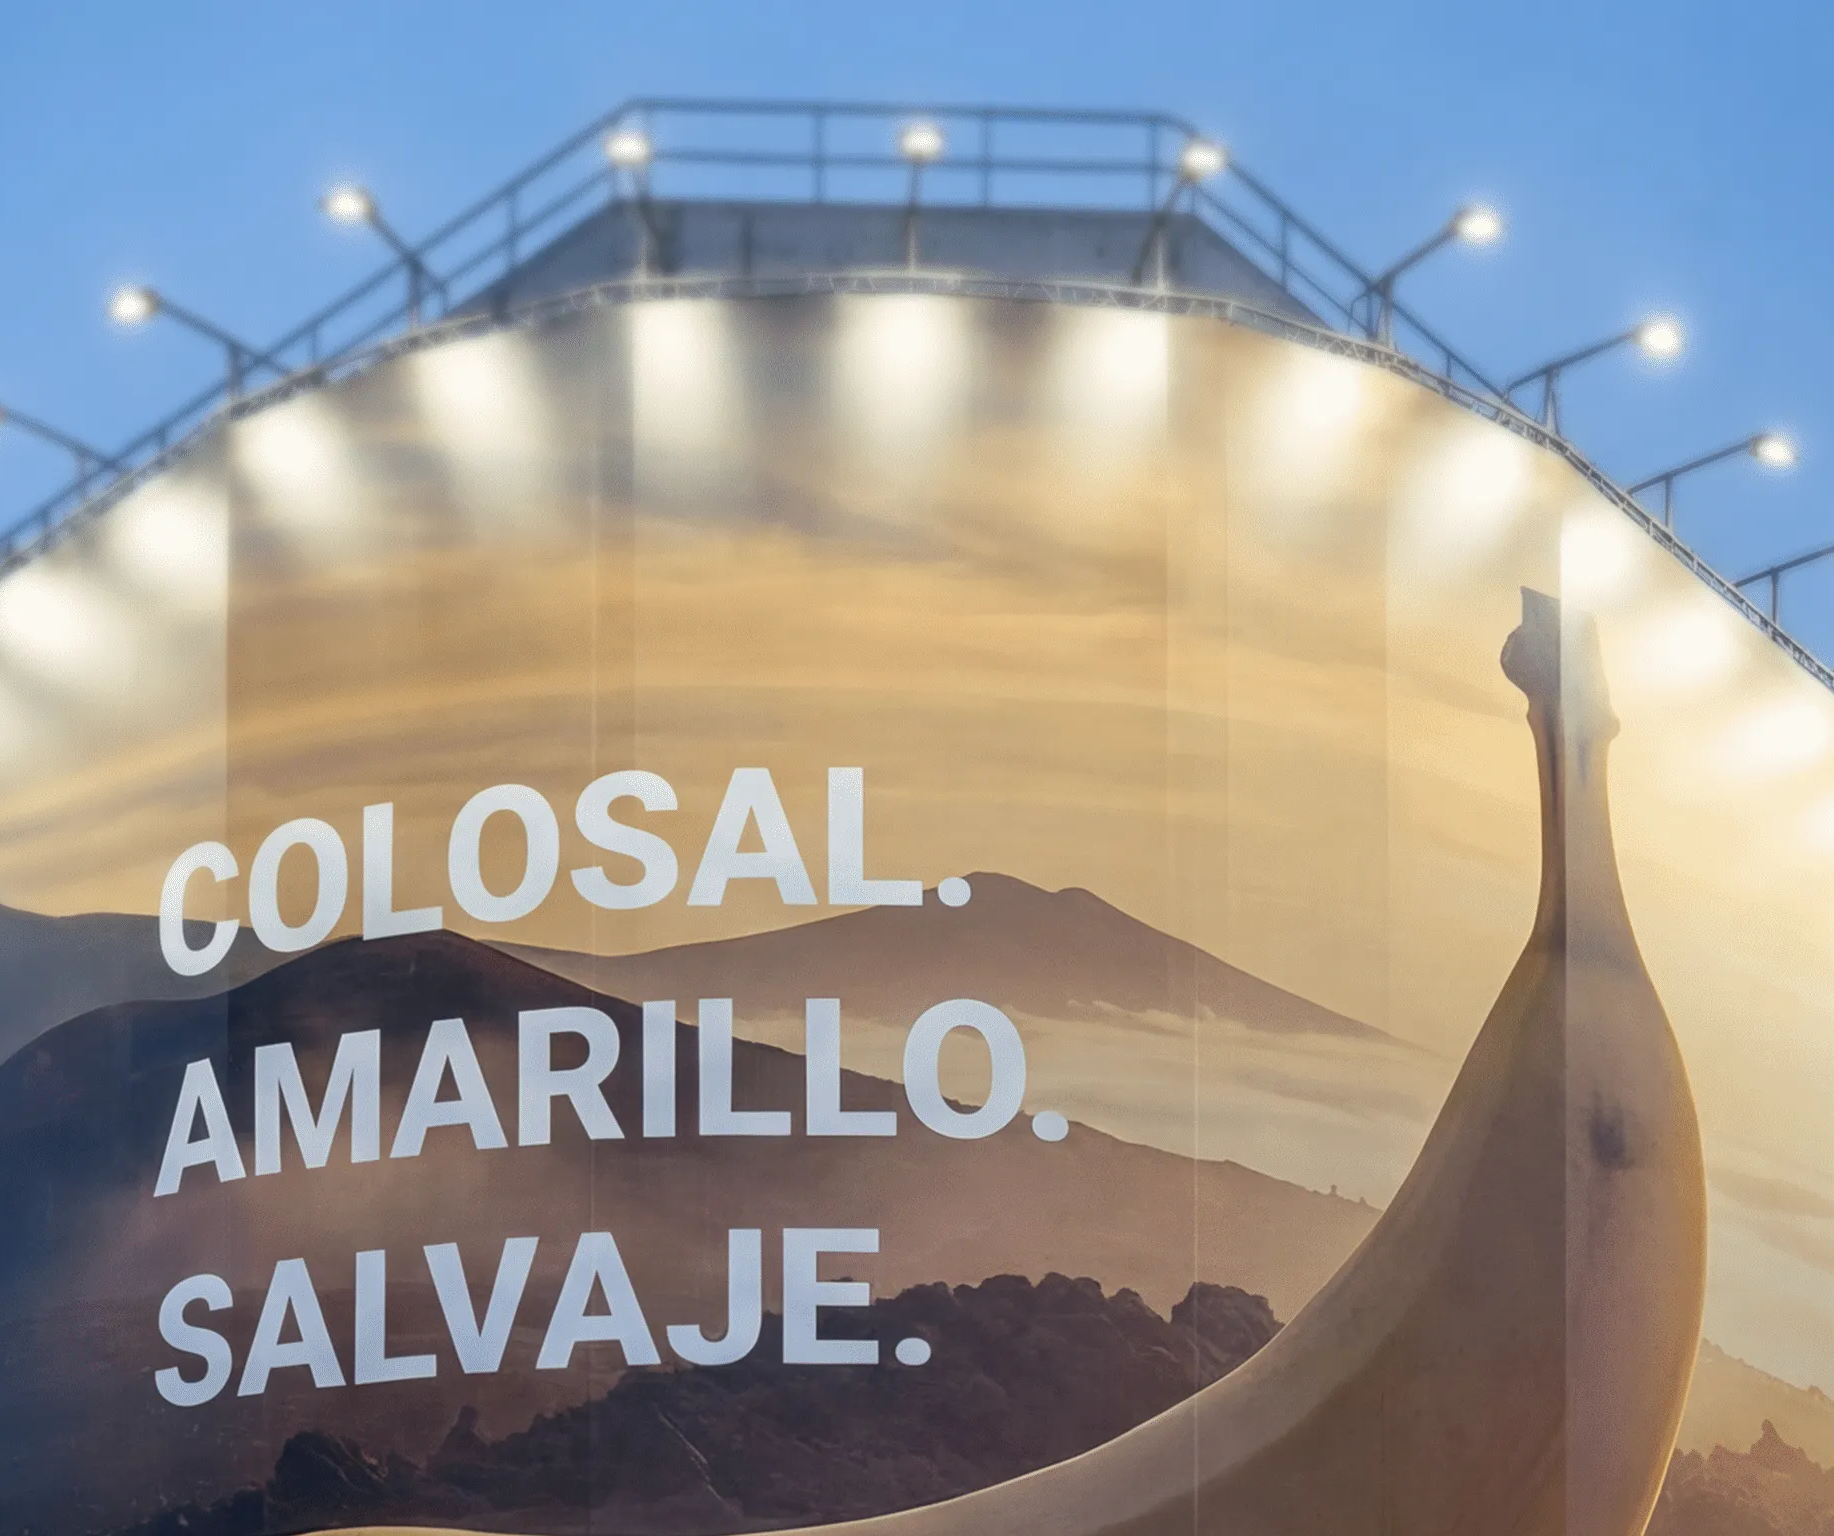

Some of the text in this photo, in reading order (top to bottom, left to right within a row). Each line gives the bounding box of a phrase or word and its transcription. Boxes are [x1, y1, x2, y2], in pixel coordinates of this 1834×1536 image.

[158, 765, 973, 977] COLOSAL.
[153, 997, 1070, 1198] AMARILLO.
[153, 1227, 932, 1408] SALVAJE.
